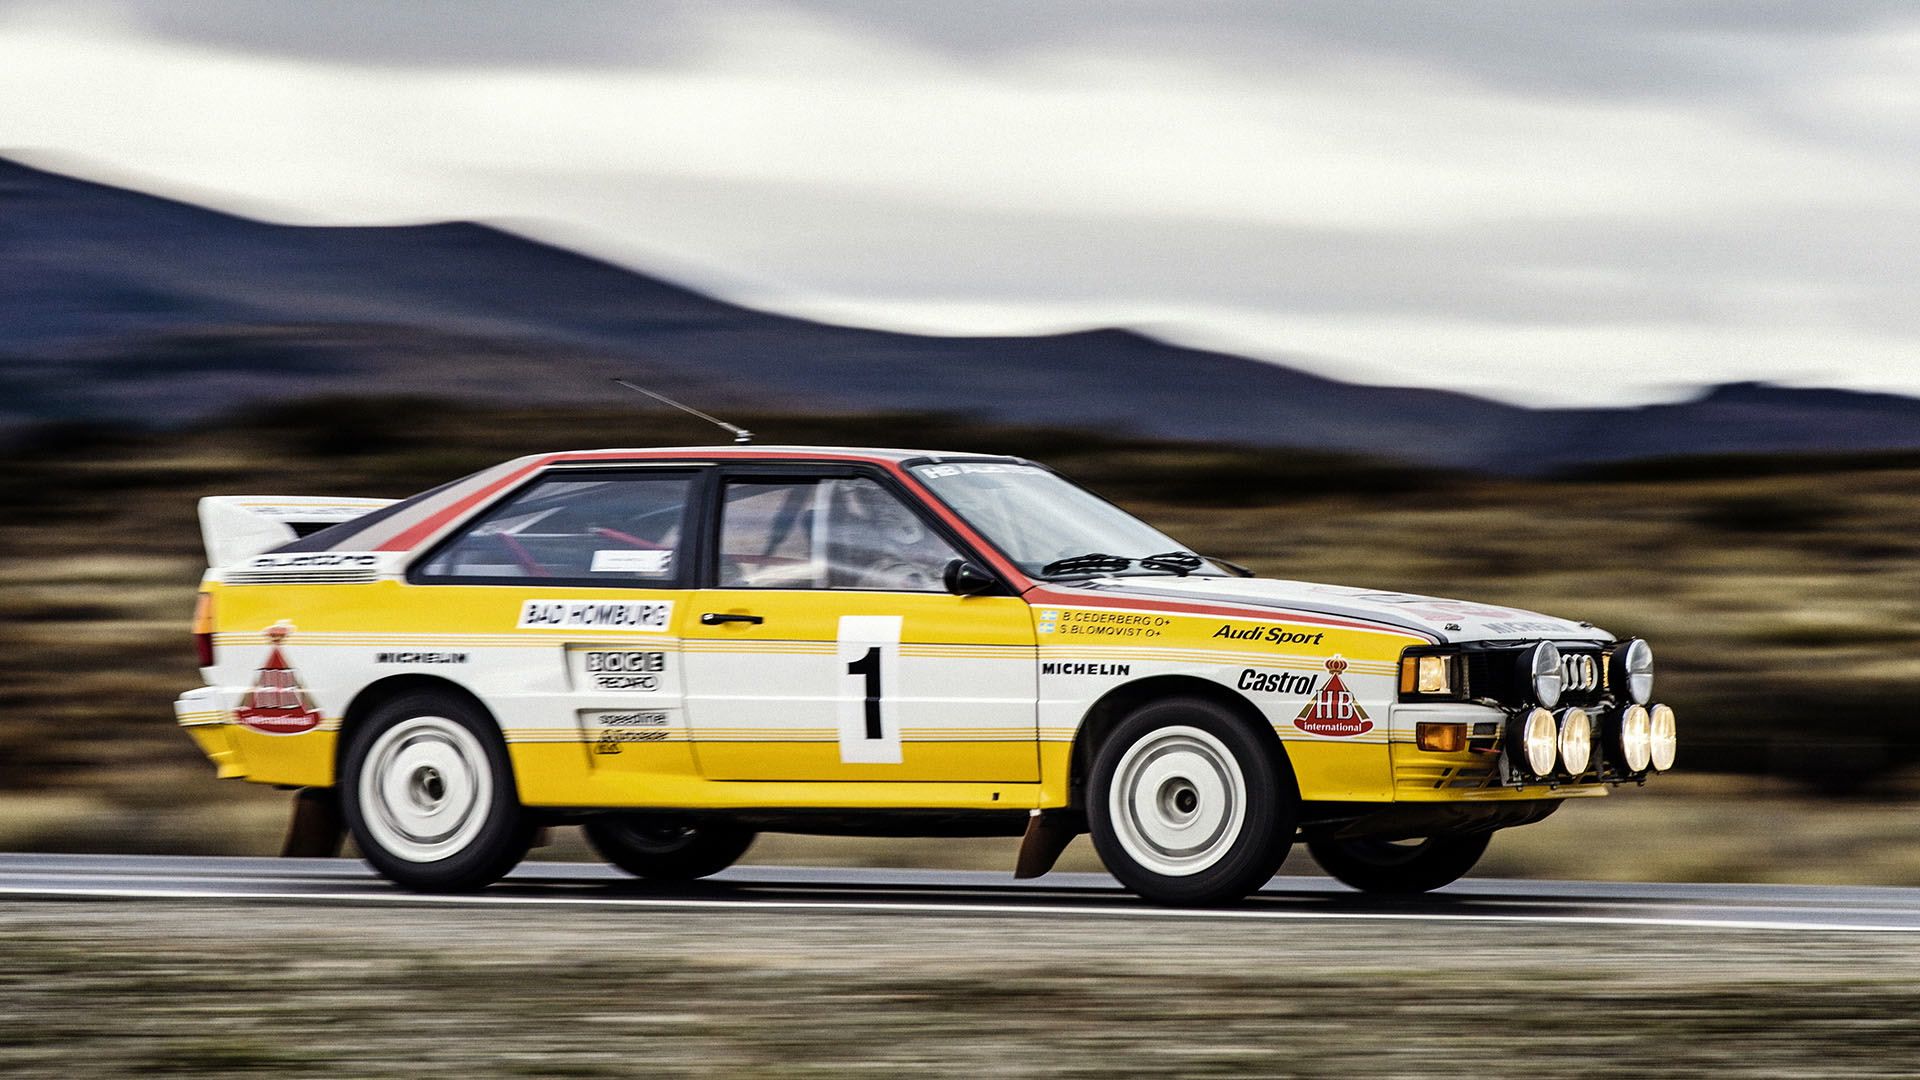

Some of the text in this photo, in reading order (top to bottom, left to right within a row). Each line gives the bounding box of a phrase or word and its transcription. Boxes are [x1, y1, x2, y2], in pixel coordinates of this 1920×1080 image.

[526, 603, 667, 627] BAD HOMBURG
[1212, 624, 1324, 646] Audi Sport
[376, 652, 467, 664] MICHELIN
[585, 652, 664, 672] BOGE
[1042, 663, 1130, 676] MICHELIN
[1237, 668, 1318, 695] Castrol
[847, 646, 883, 740] 1
[1315, 690, 1355, 720] HB
[1303, 721, 1362, 732] international
